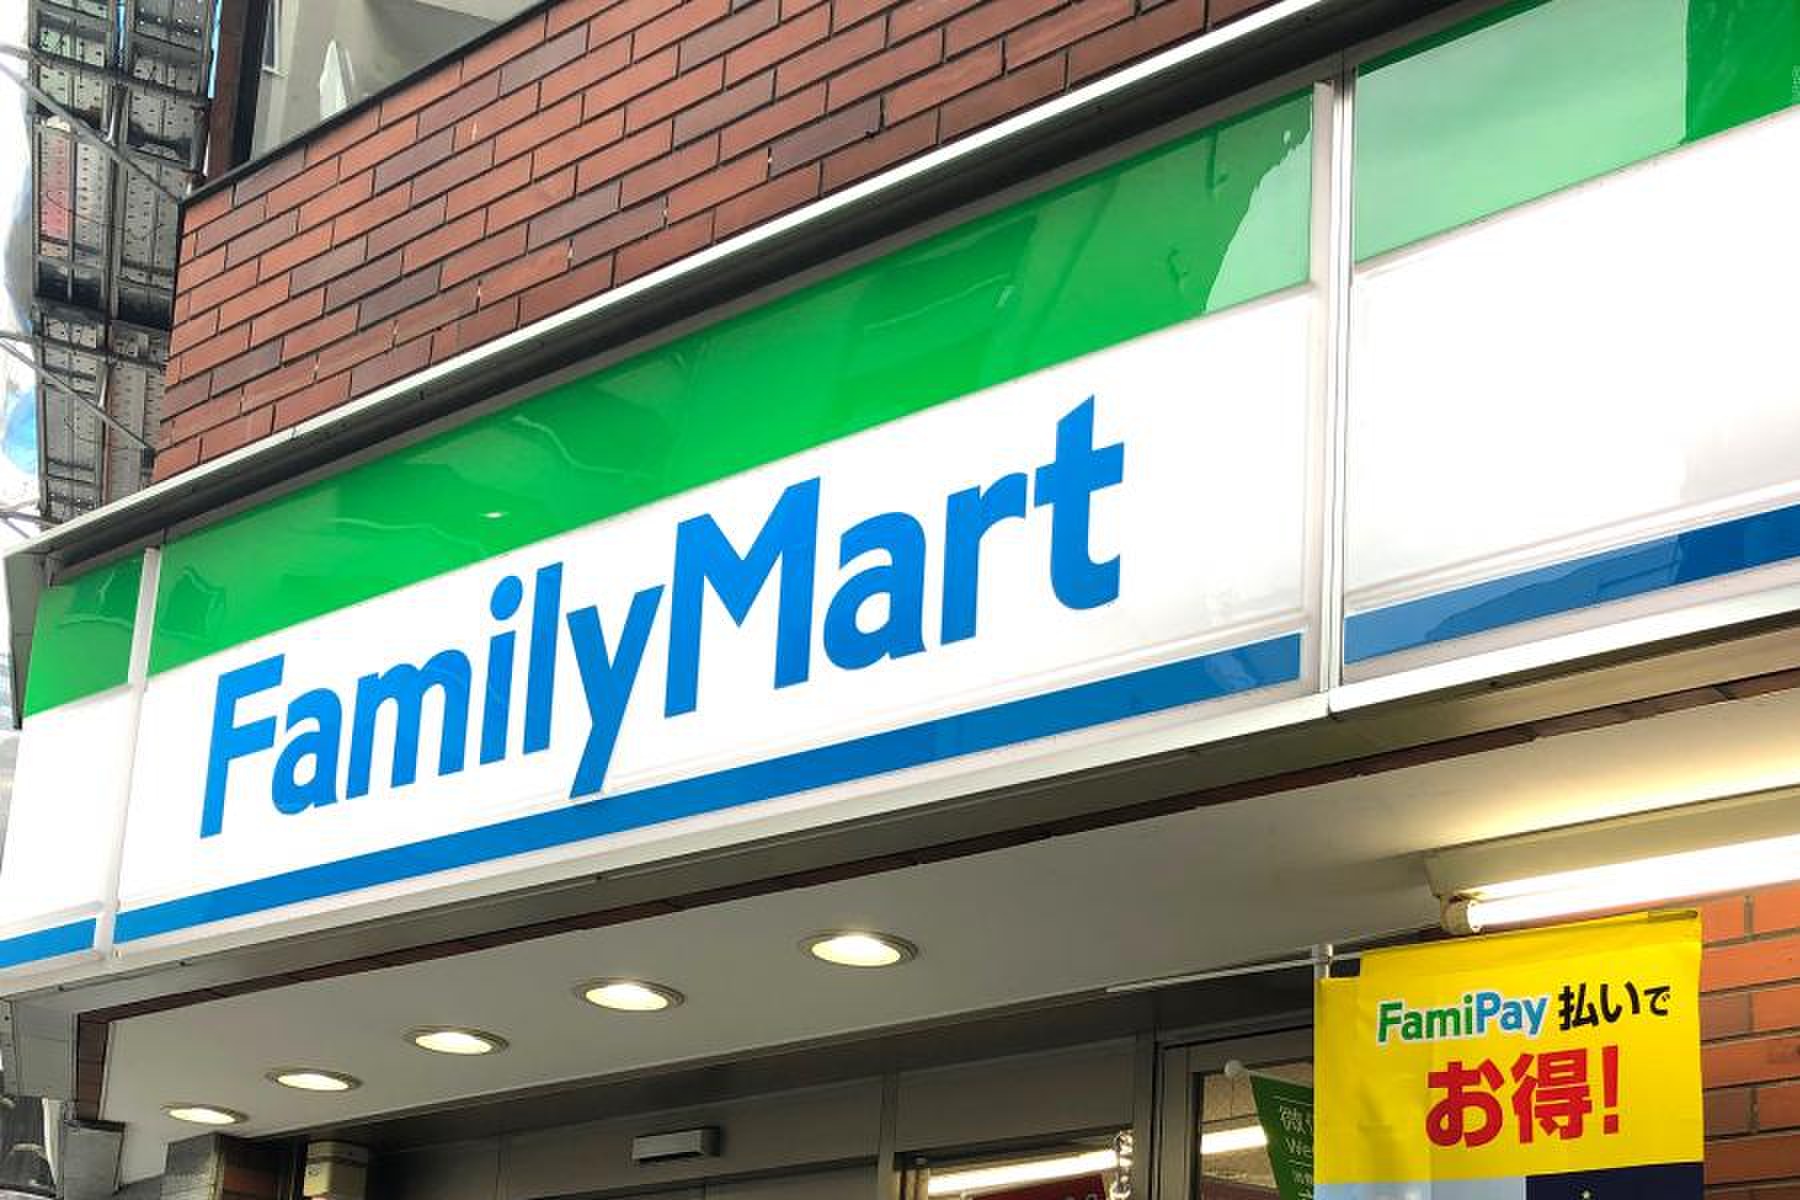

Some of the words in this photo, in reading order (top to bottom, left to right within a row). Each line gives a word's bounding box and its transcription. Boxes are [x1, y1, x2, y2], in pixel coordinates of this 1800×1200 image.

[200, 394, 1124, 838] FamilyMart
[1377, 992, 1549, 1044] FamiPay
[1557, 981, 1673, 1033] 払いで
[1424, 1046, 1622, 1148] お得!
